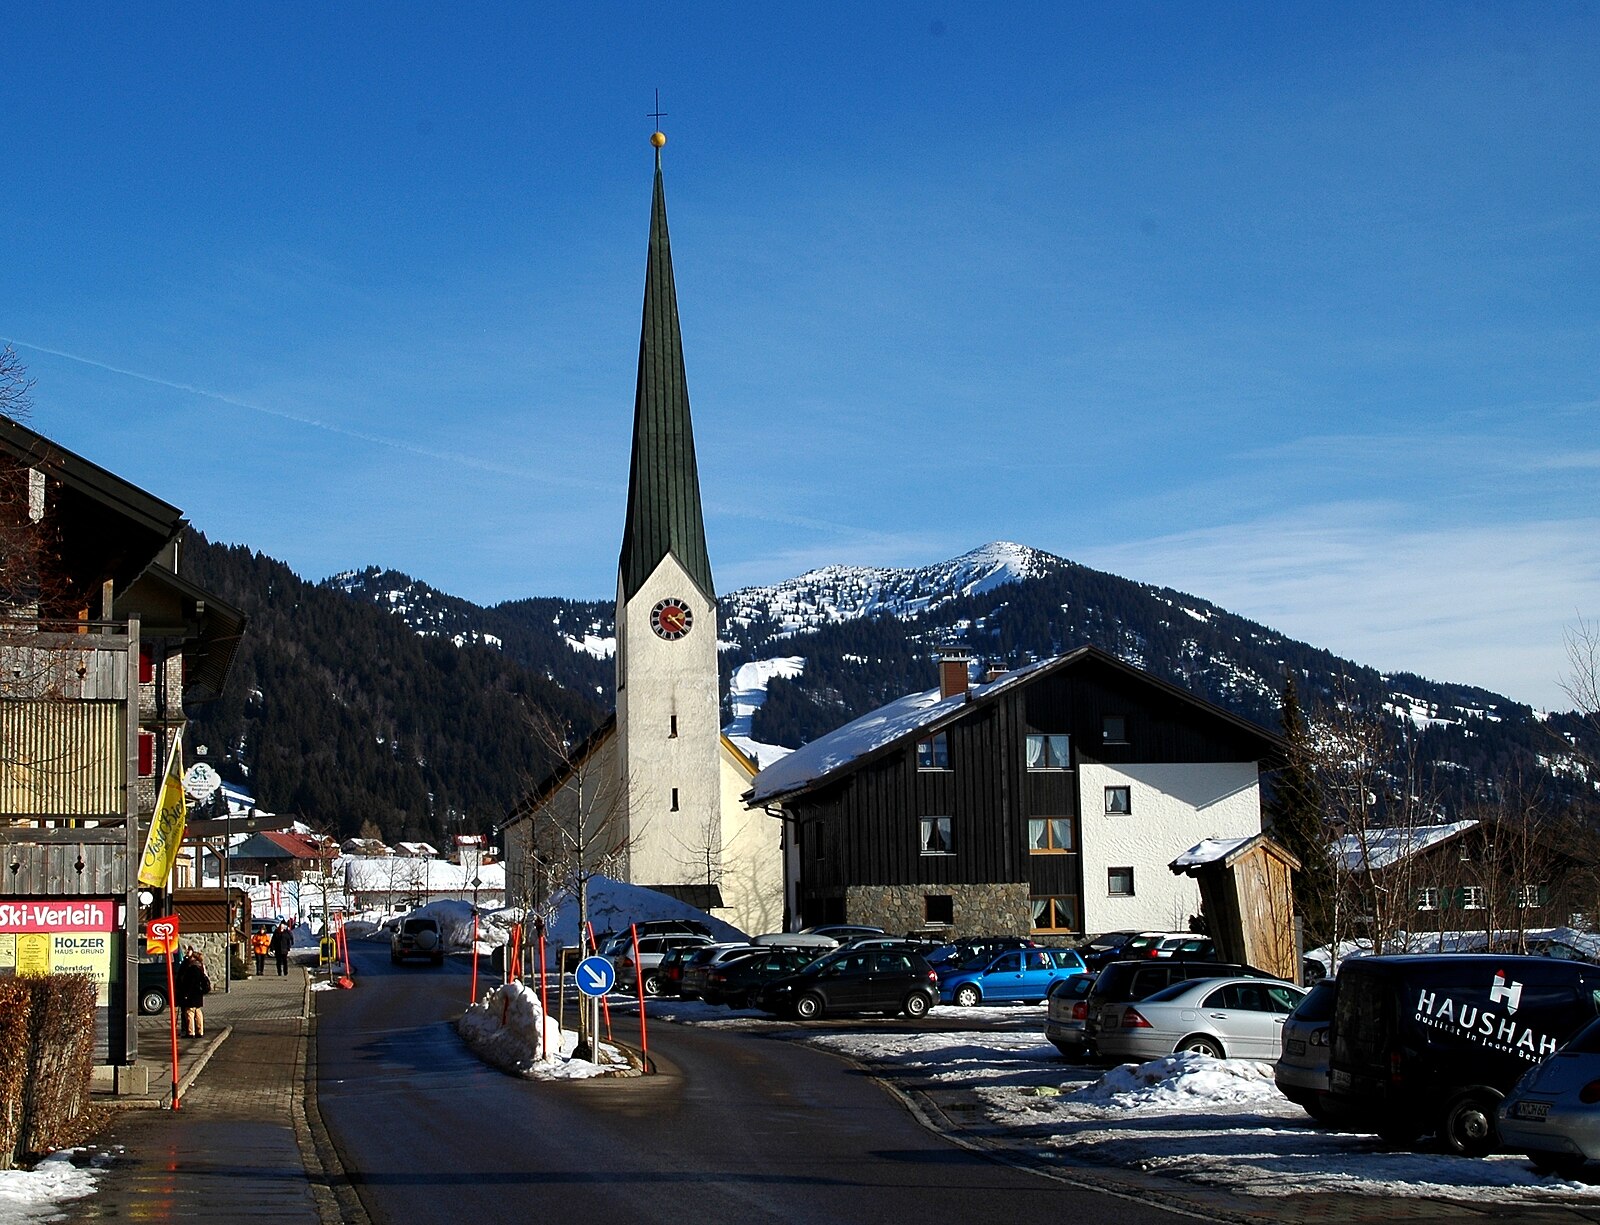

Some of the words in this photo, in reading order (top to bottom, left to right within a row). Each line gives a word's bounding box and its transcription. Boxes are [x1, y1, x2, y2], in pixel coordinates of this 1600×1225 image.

[0, 904, 104, 926] Ski-Verleih
[55, 937, 104, 948] HOLZER
[1415, 1012, 1461, 1036] Qualität
[1466, 1031, 1477, 1042] in
[1482, 1037, 1513, 1054] jeder
